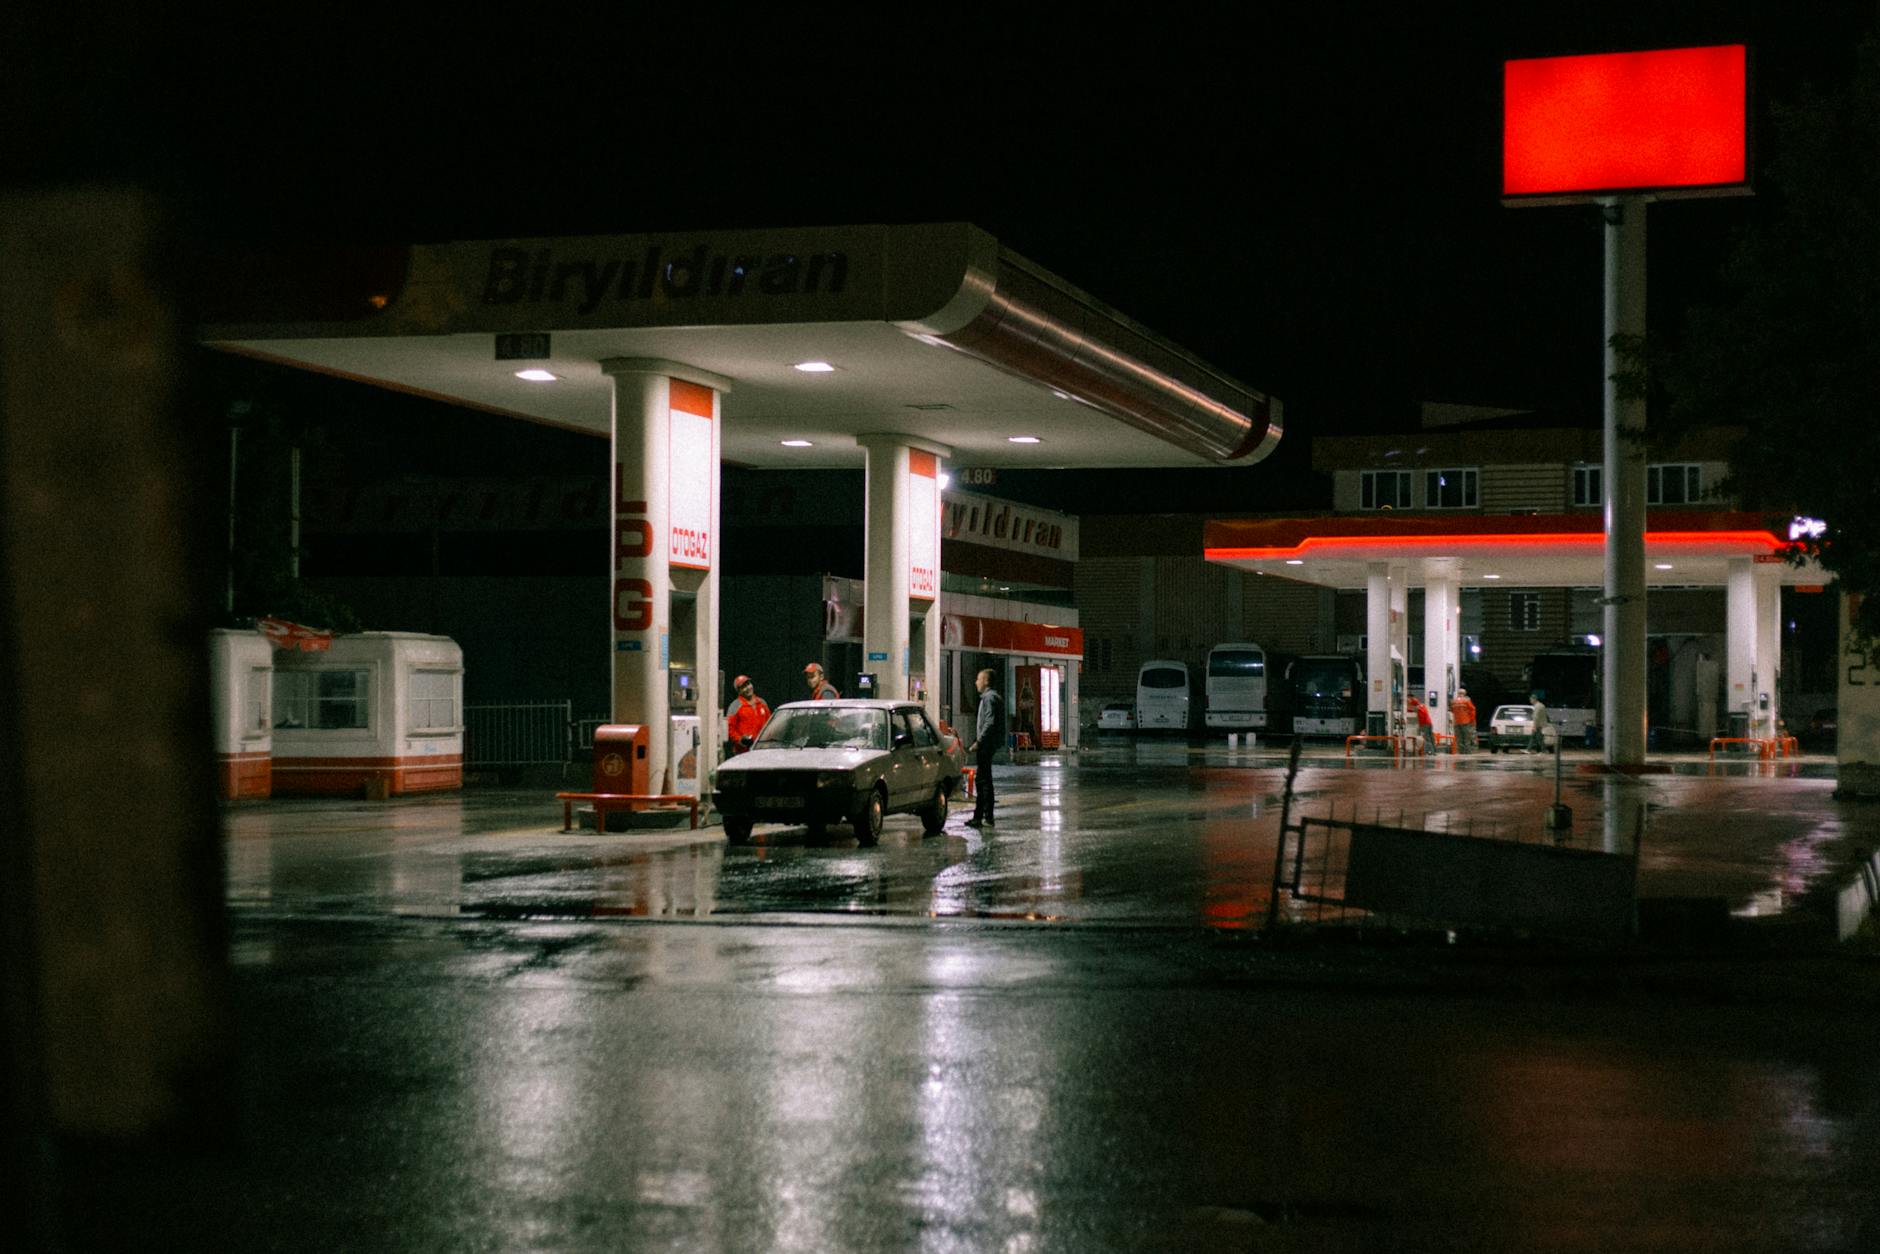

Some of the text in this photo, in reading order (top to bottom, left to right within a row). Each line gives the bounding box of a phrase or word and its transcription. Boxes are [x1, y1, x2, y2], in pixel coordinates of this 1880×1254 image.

[961, 469, 993, 484] 4.80
[614, 463, 654, 632] LPG
[672, 527, 708, 560] OTOGAZ
[912, 567, 933, 592] OTOGAZ
[1044, 635, 1070, 648] MARKET
